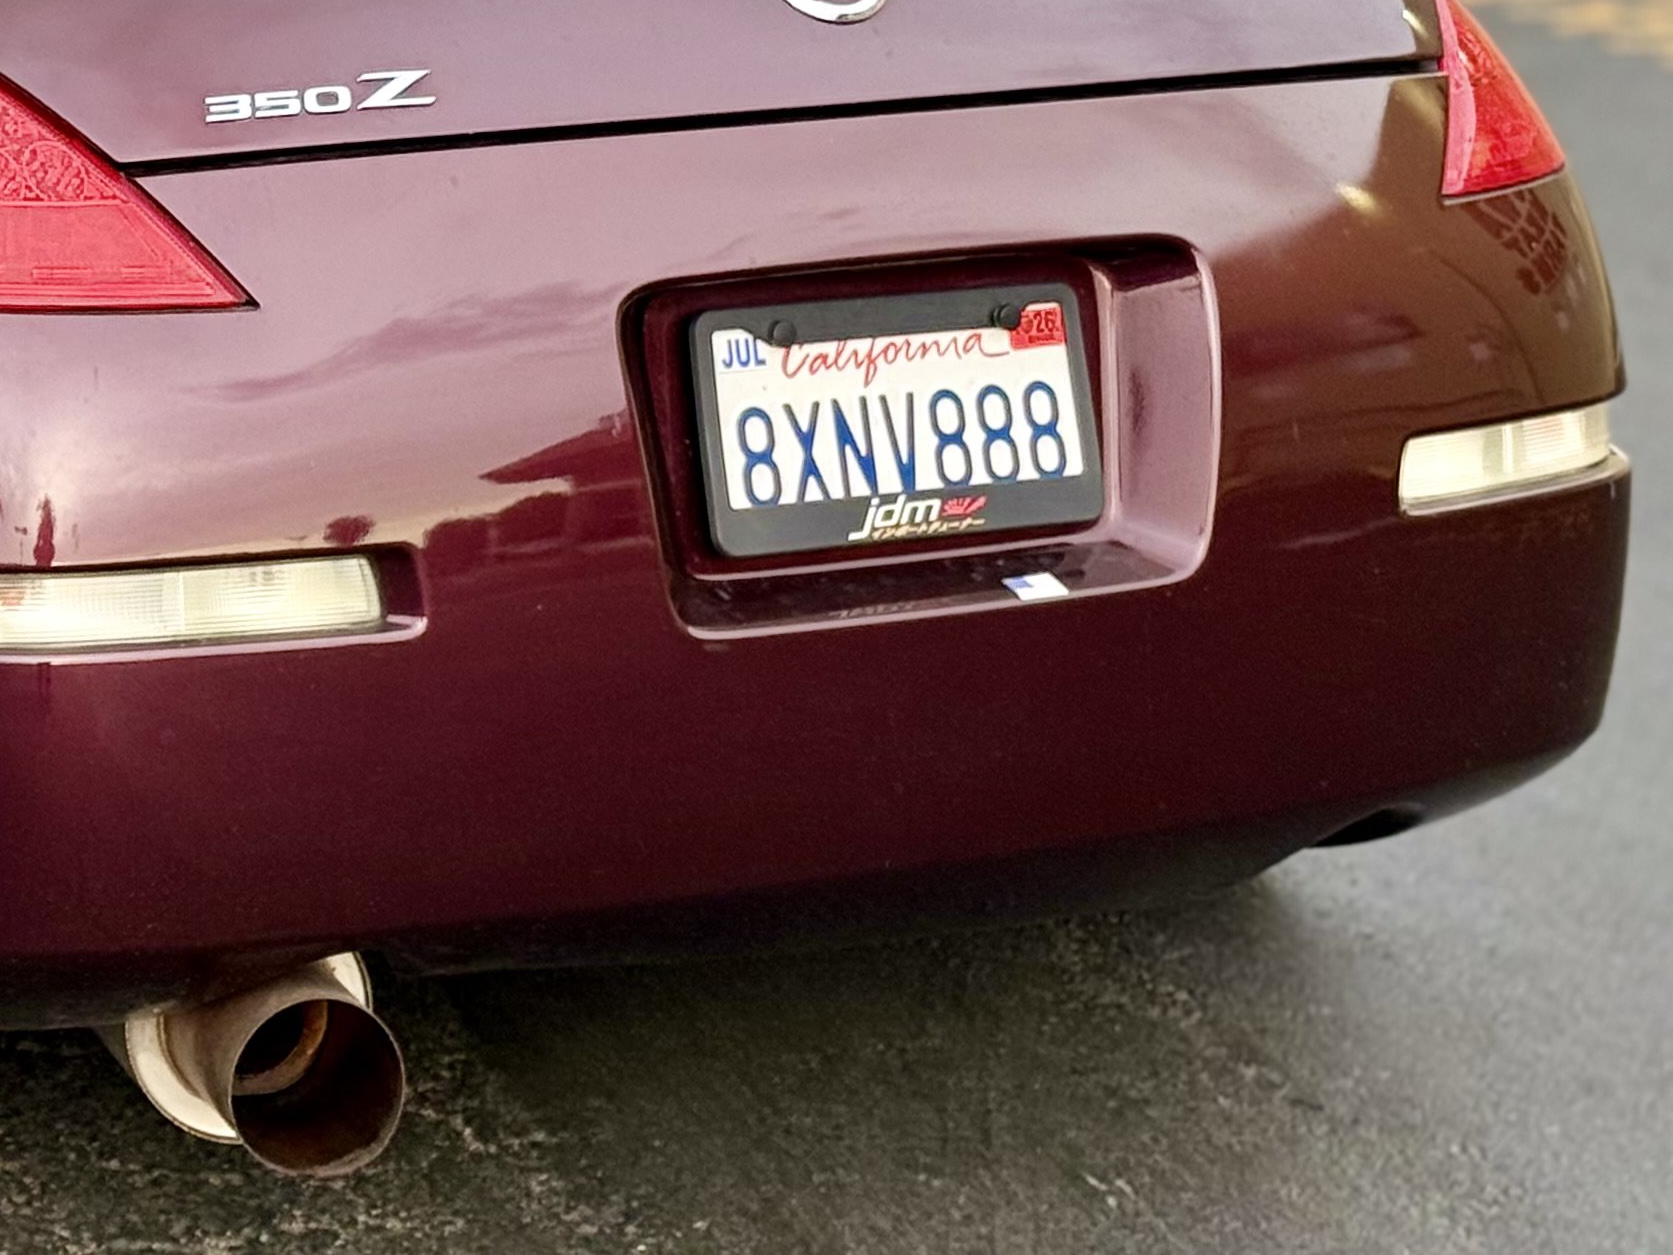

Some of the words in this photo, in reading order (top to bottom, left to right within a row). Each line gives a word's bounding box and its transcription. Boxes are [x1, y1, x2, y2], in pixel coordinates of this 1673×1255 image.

[204, 69, 437, 124] 350Z
[721, 336, 767, 369] JUL
[781, 331, 1010, 388] California
[737, 380, 1068, 507] 8XNV888
[847, 493, 942, 542] jdm
